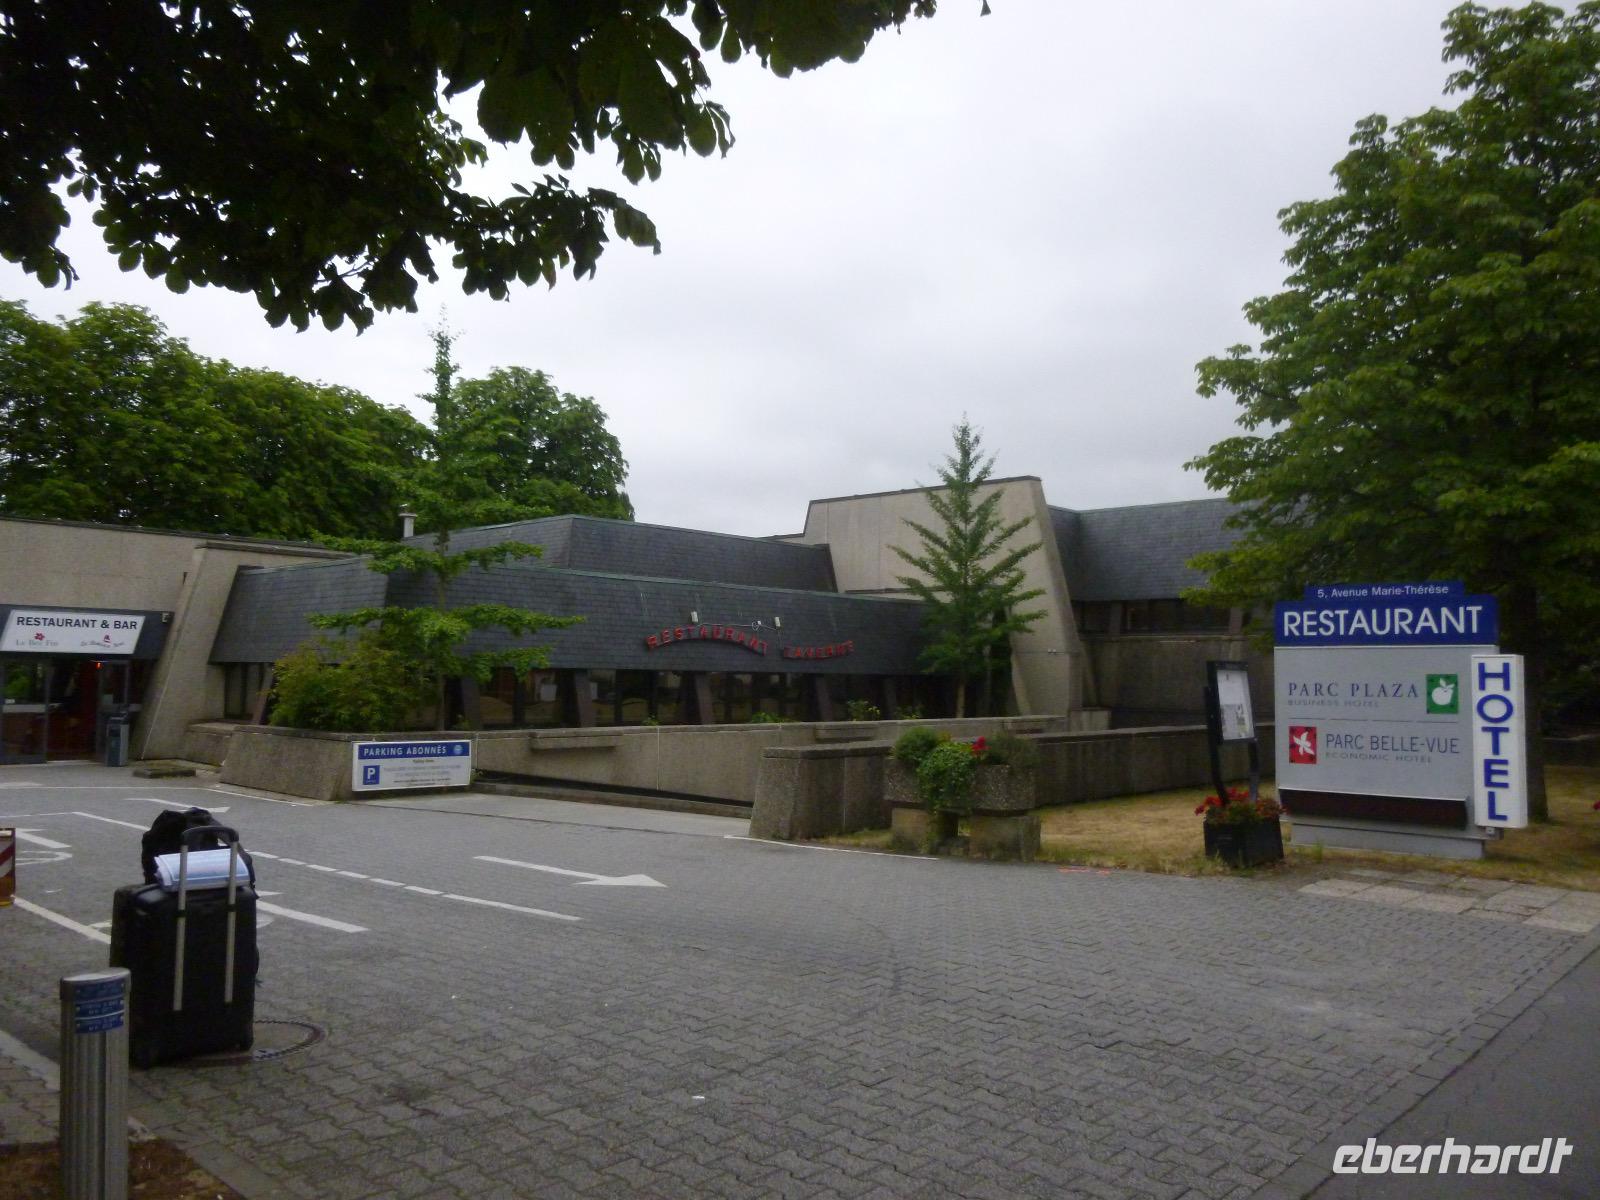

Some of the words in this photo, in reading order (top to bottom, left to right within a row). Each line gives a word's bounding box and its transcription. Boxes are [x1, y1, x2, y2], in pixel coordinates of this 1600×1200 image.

[1331, 588, 1368, 598] Avenue
[1371, 585, 1449, 597] Marie-Thérèse
[16, 616, 97, 629] RESTAURANT
[100, 619, 110, 629] &
[113, 620, 138, 630] BAR
[1283, 605, 1483, 637] RESTAURANT
[646, 626, 768, 656] RESTAURANT
[783, 639, 855, 659] TAVERNE
[1288, 682, 1339, 698] PARC
[1350, 682, 1419, 698] PLAZA
[1287, 699, 1340, 707] BUSINESS
[1343, 700, 1380, 708] HOTEL
[1325, 733, 1364, 750] PARC
[1370, 735, 1460, 754] BELLE-VUE
[1476, 662, 1514, 821] HOTEL
[364, 748, 403, 756] PARKING
[406, 744, 447, 756] ABONNÉS
[1325, 752, 1390, 762] ECONOMIC
[1394, 754, 1432, 763] HOTEL
[367, 768, 376, 779] P
